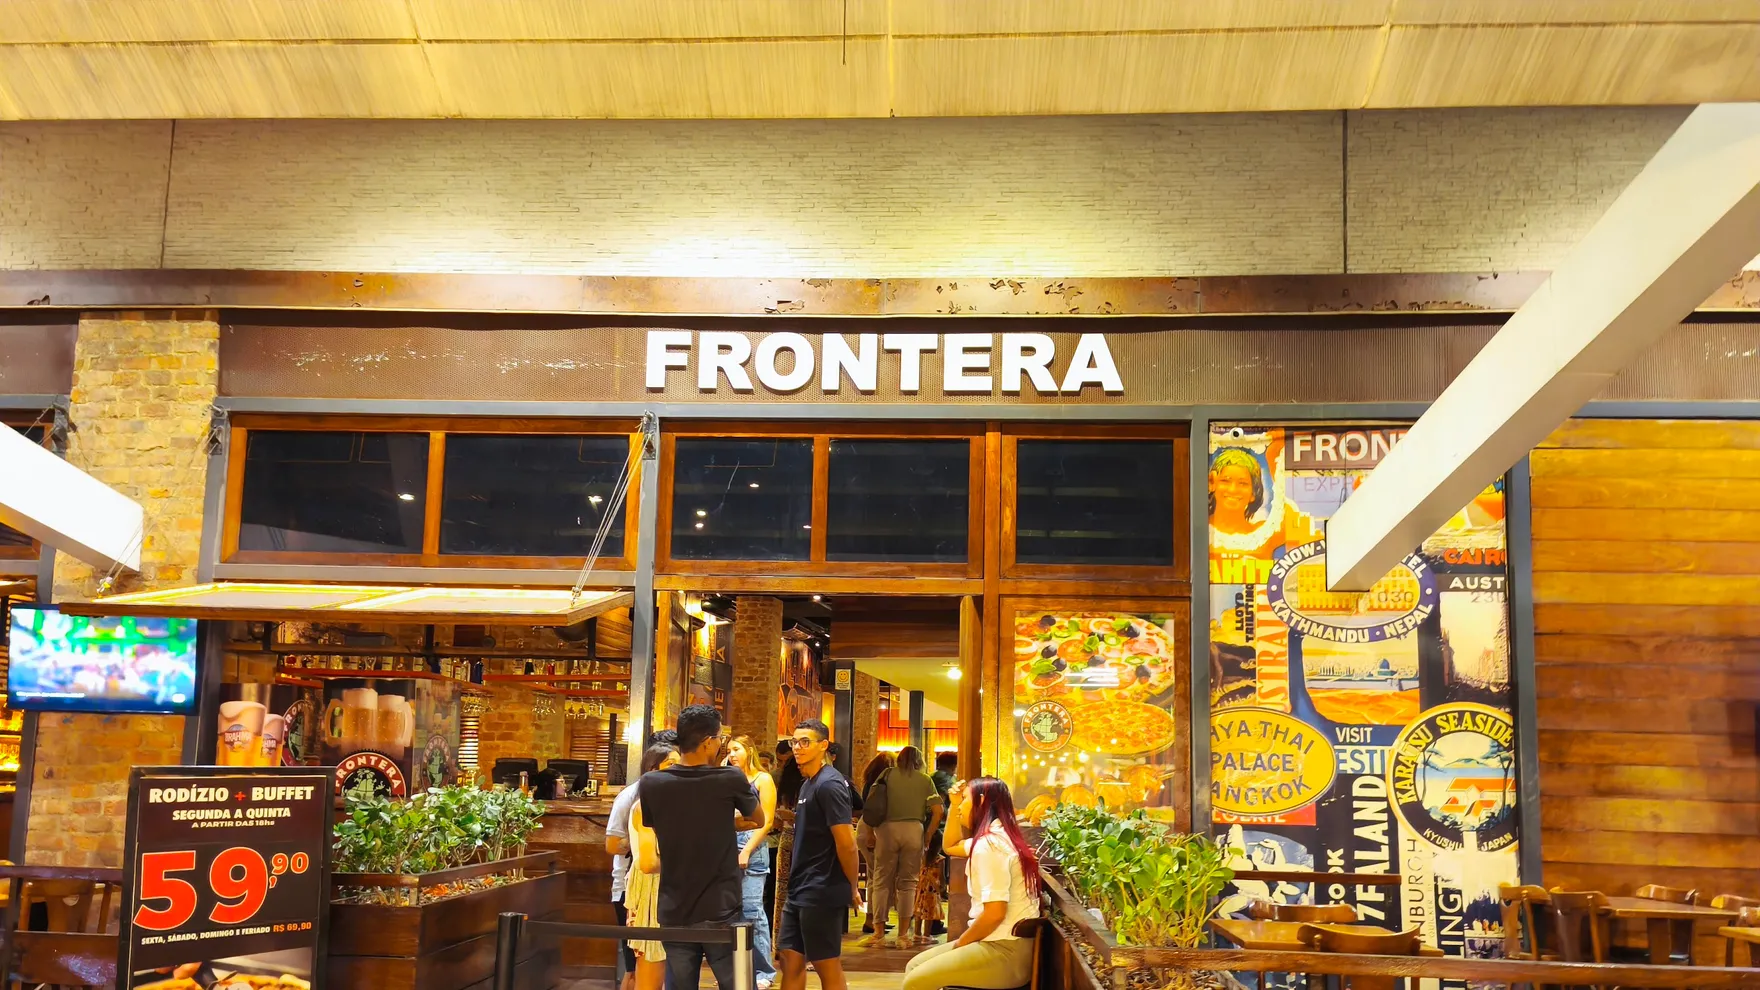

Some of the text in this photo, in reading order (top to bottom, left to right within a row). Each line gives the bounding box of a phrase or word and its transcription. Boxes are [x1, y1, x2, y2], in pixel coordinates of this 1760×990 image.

[645, 330, 1124, 393] FRONTERA
[1293, 430, 1407, 461] FRON
[1443, 548, 1505, 566] CAIR
[1449, 577, 1505, 589] AUST
[1234, 592, 1245, 631] LLOYD
[1271, 599, 1434, 643] KATHMANDU NEPAL
[1024, 703, 1069, 724] FRONTERA
[1259, 720, 1315, 755] THAI
[1335, 727, 1373, 743] VISIT
[1210, 751, 1294, 772] PALACE
[1394, 711, 1514, 806] KARATSU SEASIDE
[149, 784, 229, 804] RODÍZIO
[251, 785, 314, 801] BUFFET
[172, 807, 291, 821] SEGUNDA A QUINTA
[235, 820, 254, 828] DAS
[255, 819, 275, 827] 18hs
[1424, 826, 1513, 853] KYUSHU JAPAN
[141, 935, 166, 945] SEXTA,
[167, 932, 198, 943] SÁBADO,
[200, 929, 234, 939] DOMINGO
[242, 926, 271, 935] FERIADO
[273, 923, 284, 932] R$
[286, 922, 312, 932] 69,90
